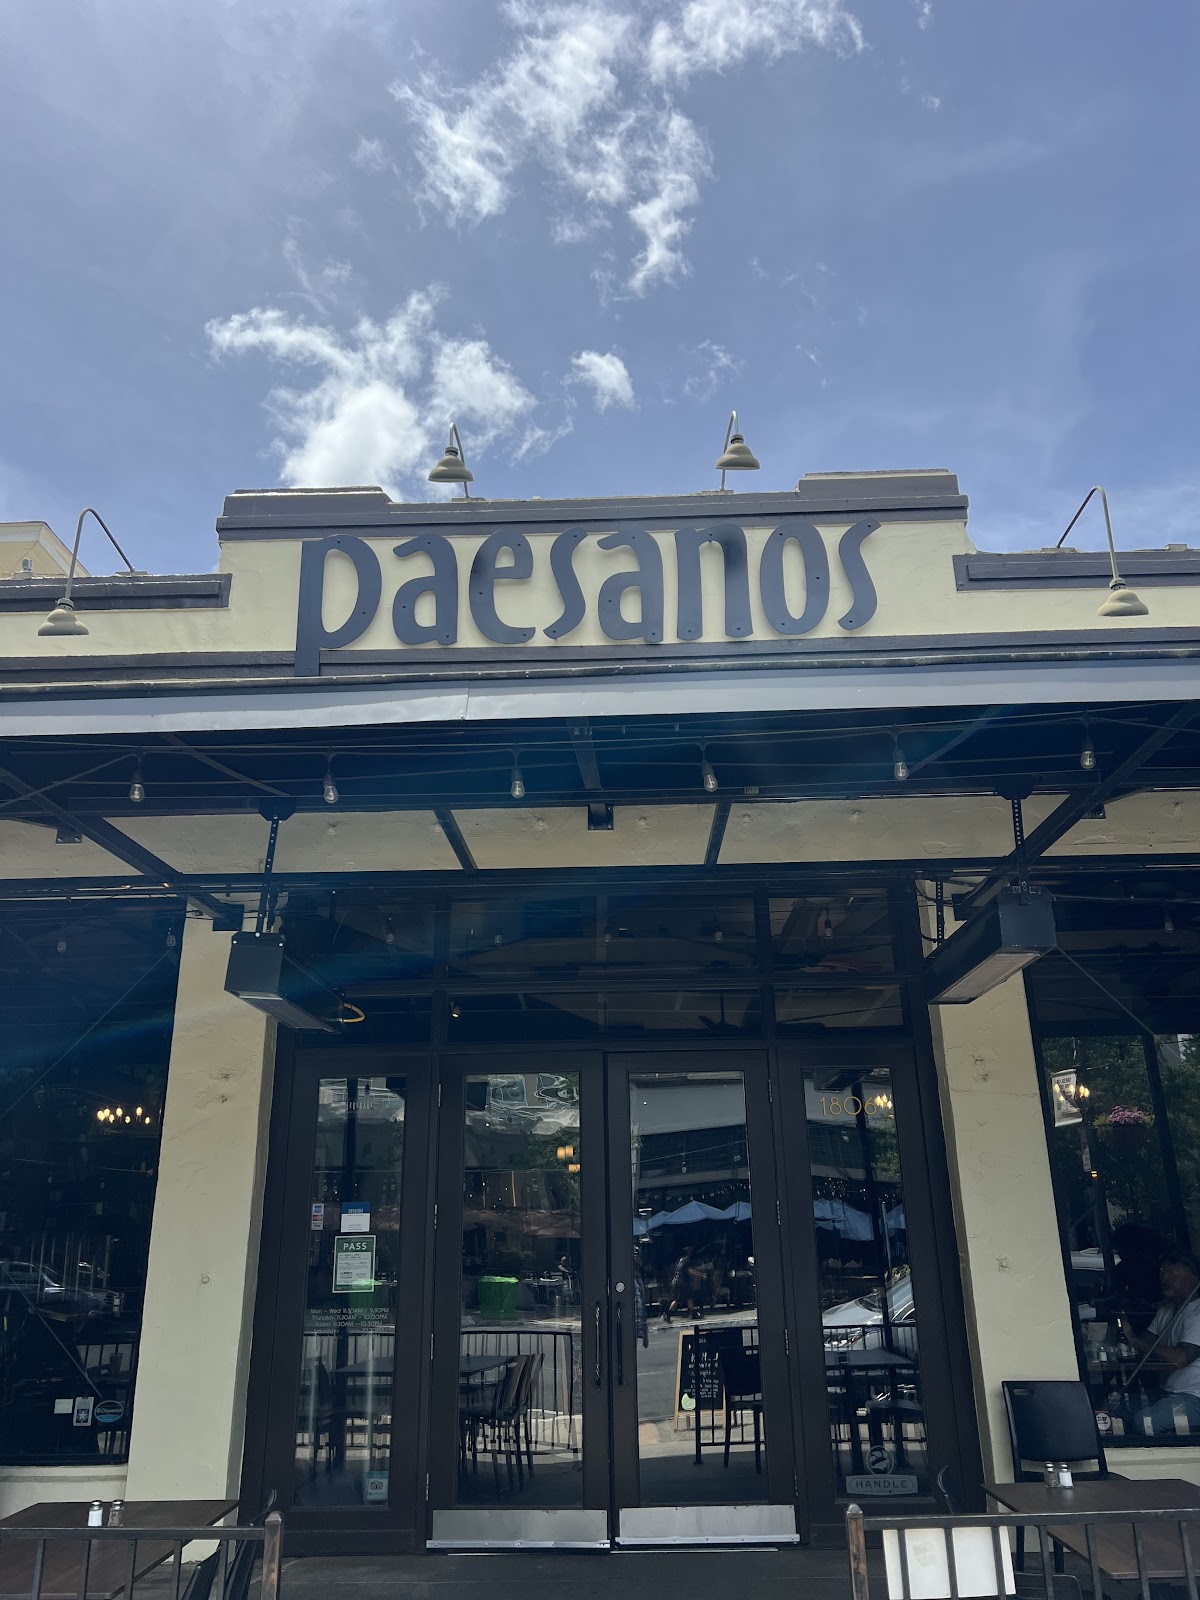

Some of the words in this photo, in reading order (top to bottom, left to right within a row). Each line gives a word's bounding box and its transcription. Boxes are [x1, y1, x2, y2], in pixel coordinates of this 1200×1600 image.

[294, 519, 881, 677] paesanos
[819, 1096, 877, 1116] 1806
[343, 1242, 367, 1251] PASS
[855, 1480, 908, 1489] HANDLE
